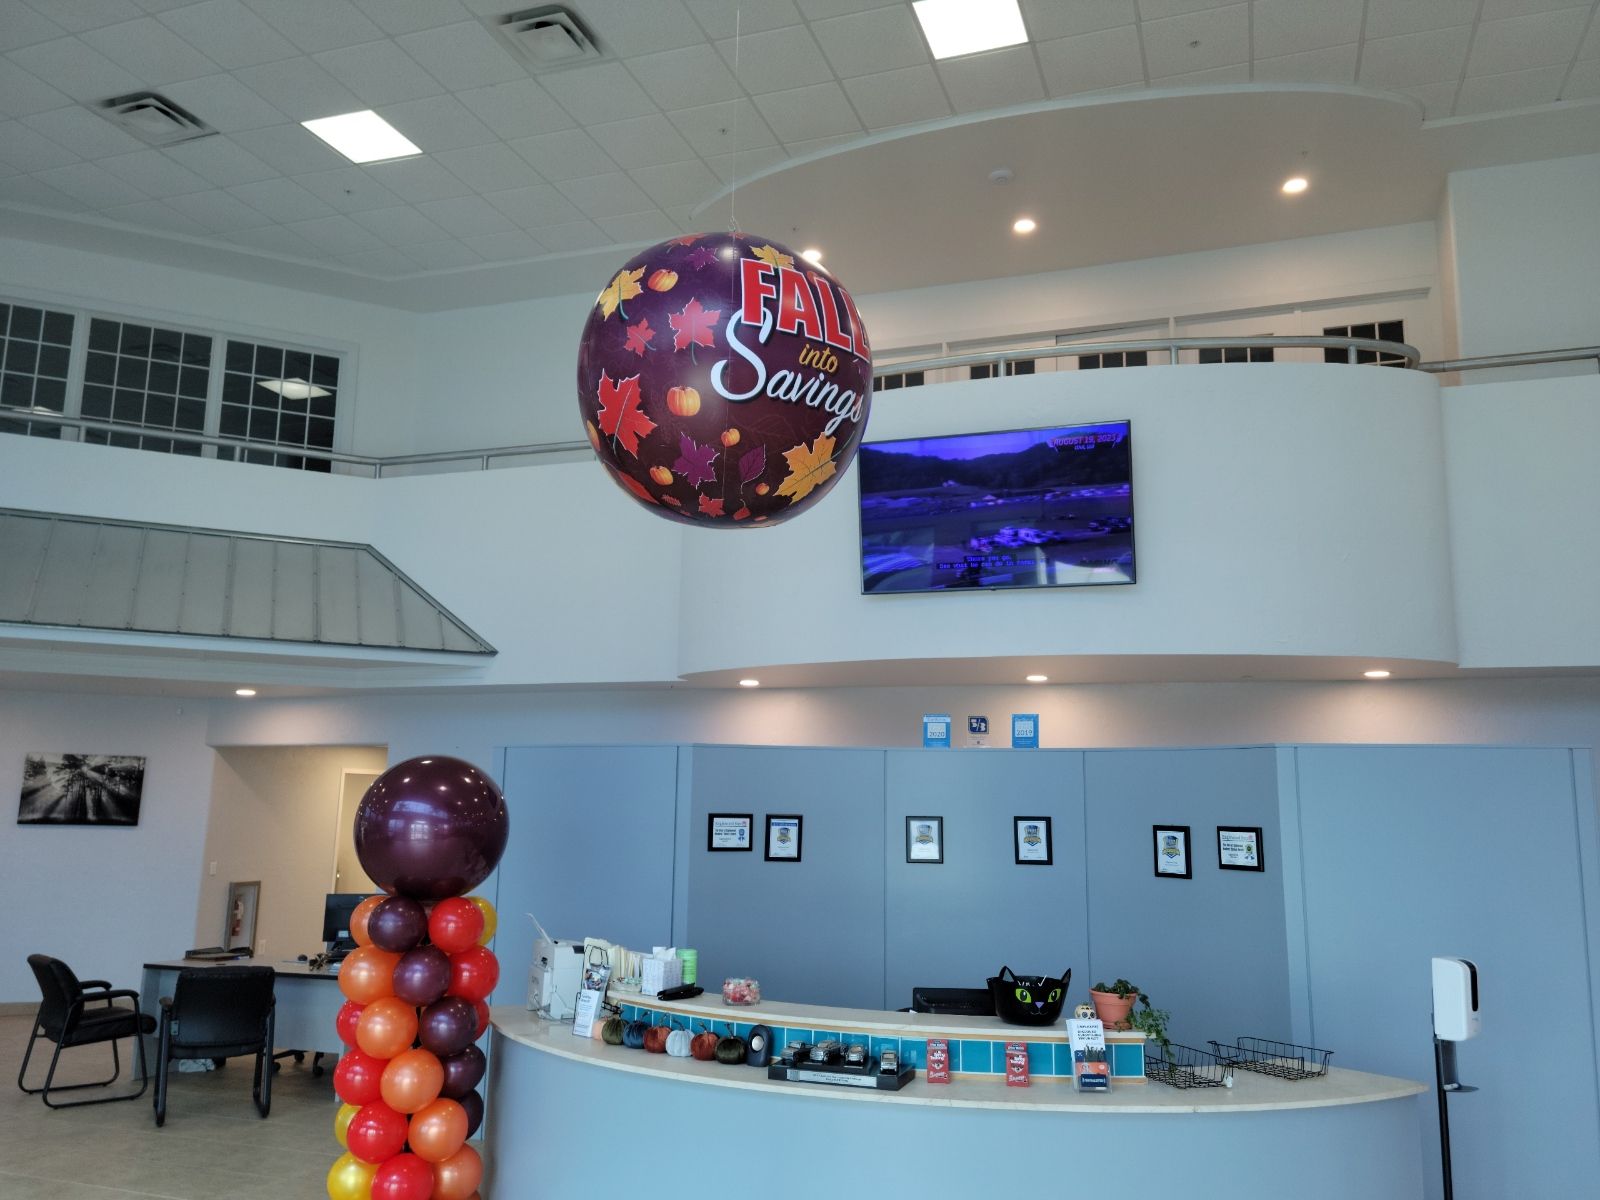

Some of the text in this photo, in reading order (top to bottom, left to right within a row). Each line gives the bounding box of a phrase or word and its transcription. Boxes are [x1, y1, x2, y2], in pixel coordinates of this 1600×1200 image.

[740, 257, 871, 364] FALL
[799, 343, 839, 373] into
[710, 307, 864, 436] Savings
